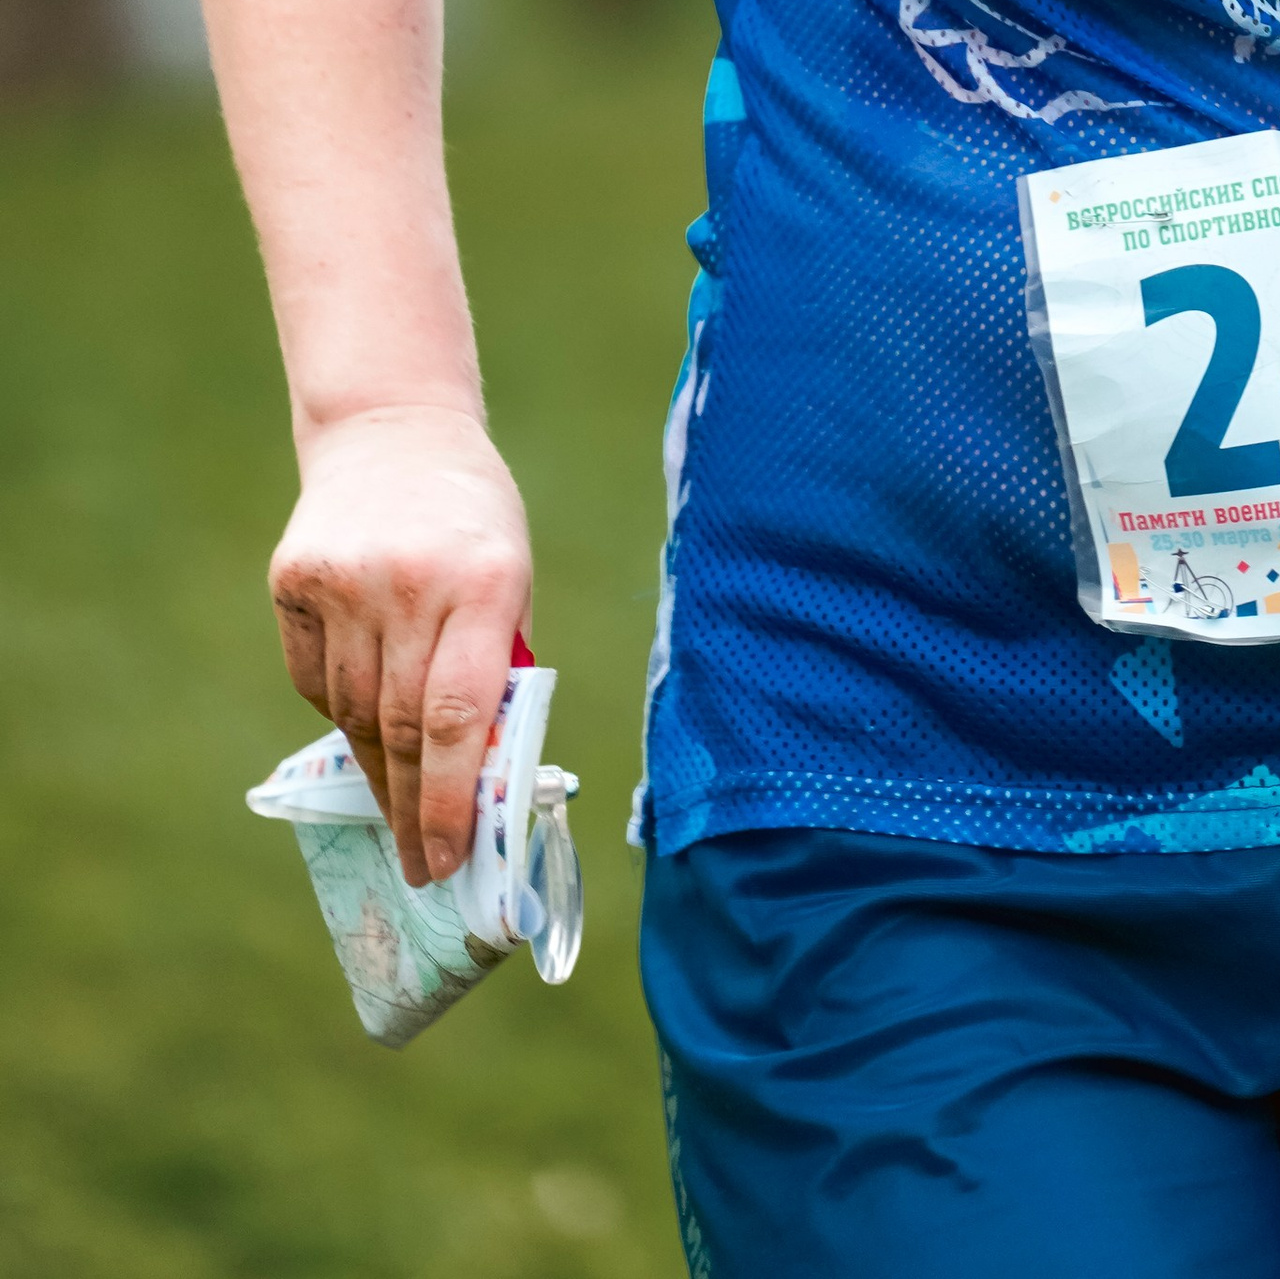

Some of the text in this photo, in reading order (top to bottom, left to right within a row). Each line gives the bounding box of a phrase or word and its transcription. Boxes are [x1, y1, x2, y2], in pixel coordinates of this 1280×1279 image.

[1066, 182, 1245, 231] ВСЕРОССИЙСКИЕ
[1123, 229, 1151, 251] ПО
[1119, 509, 1207, 532] Памяти
[1151, 530, 1205, 551] 25-30
[1211, 527, 1272, 548] марта
